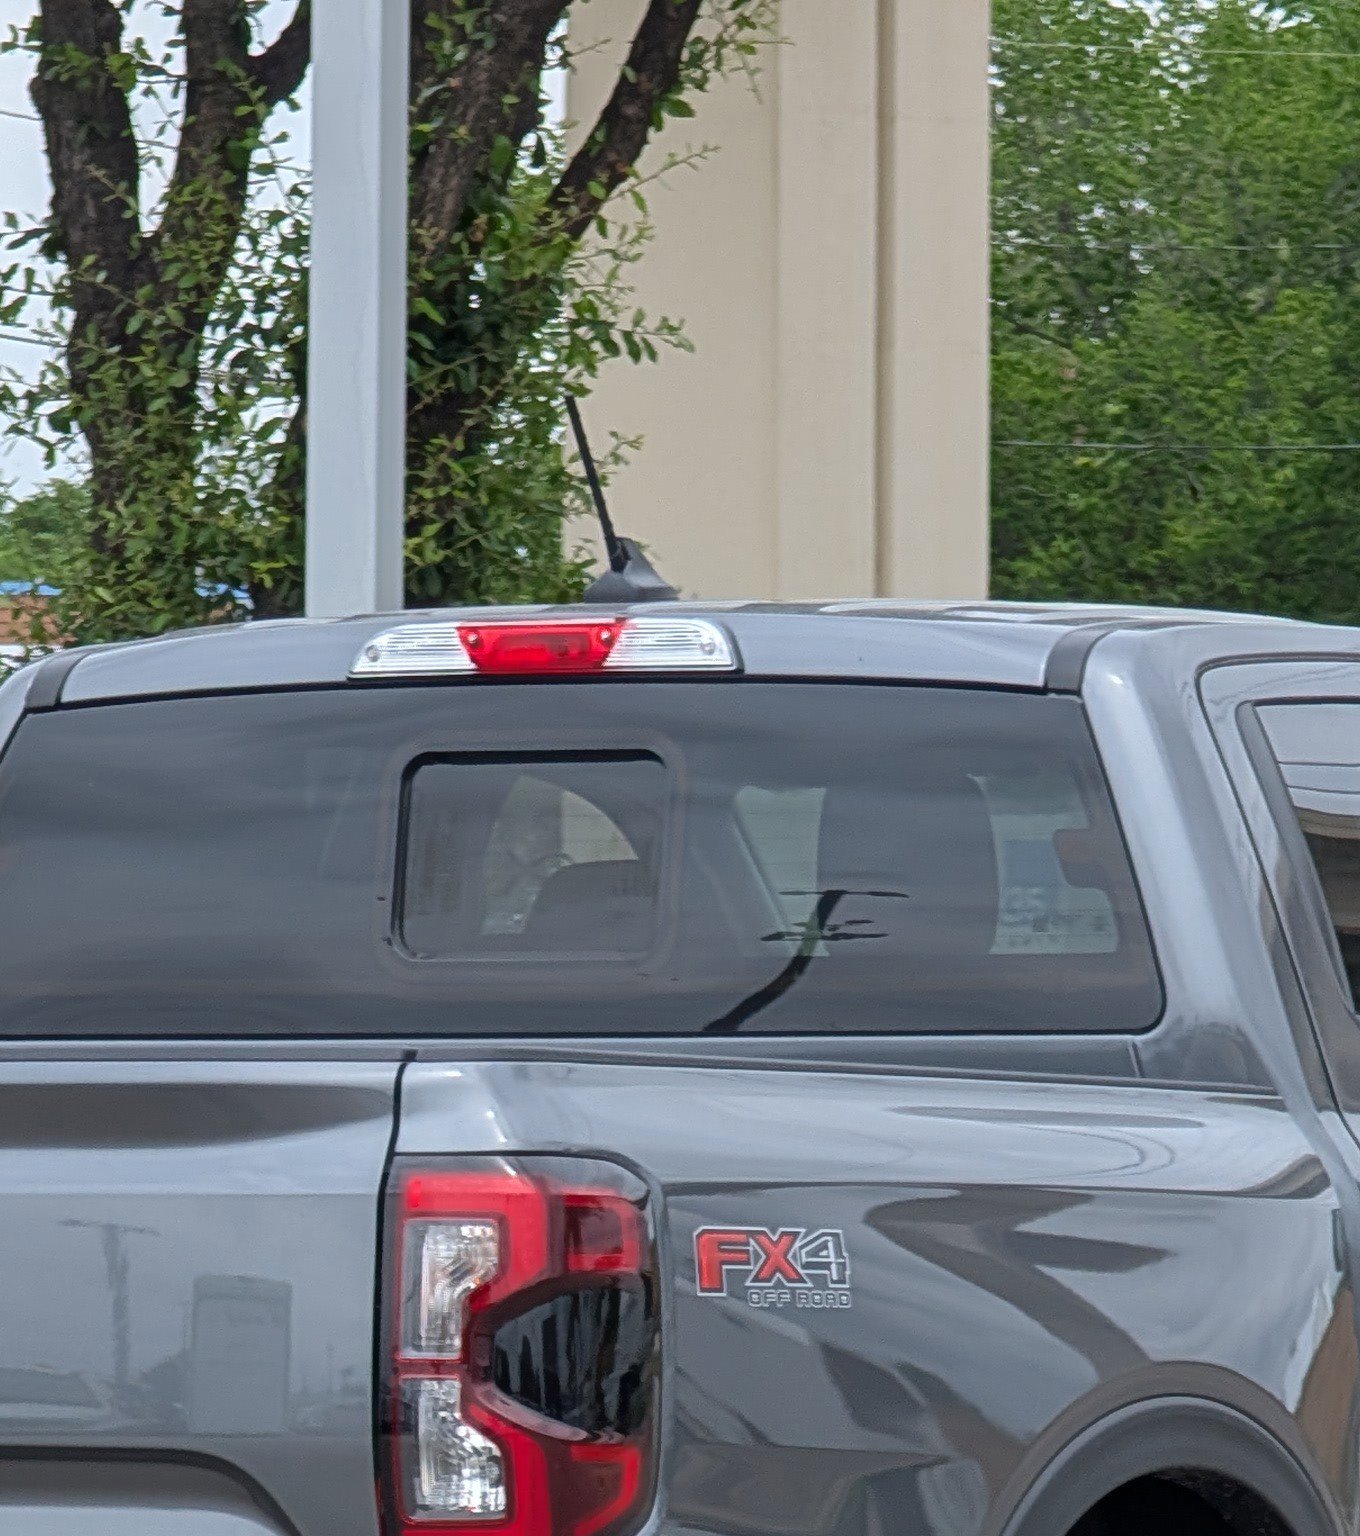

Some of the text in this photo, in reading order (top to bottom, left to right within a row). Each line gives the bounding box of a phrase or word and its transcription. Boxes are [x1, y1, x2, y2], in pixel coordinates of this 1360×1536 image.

[693, 1225, 850, 1296] FX4
[747, 1289, 852, 1309] OFF ROAD
